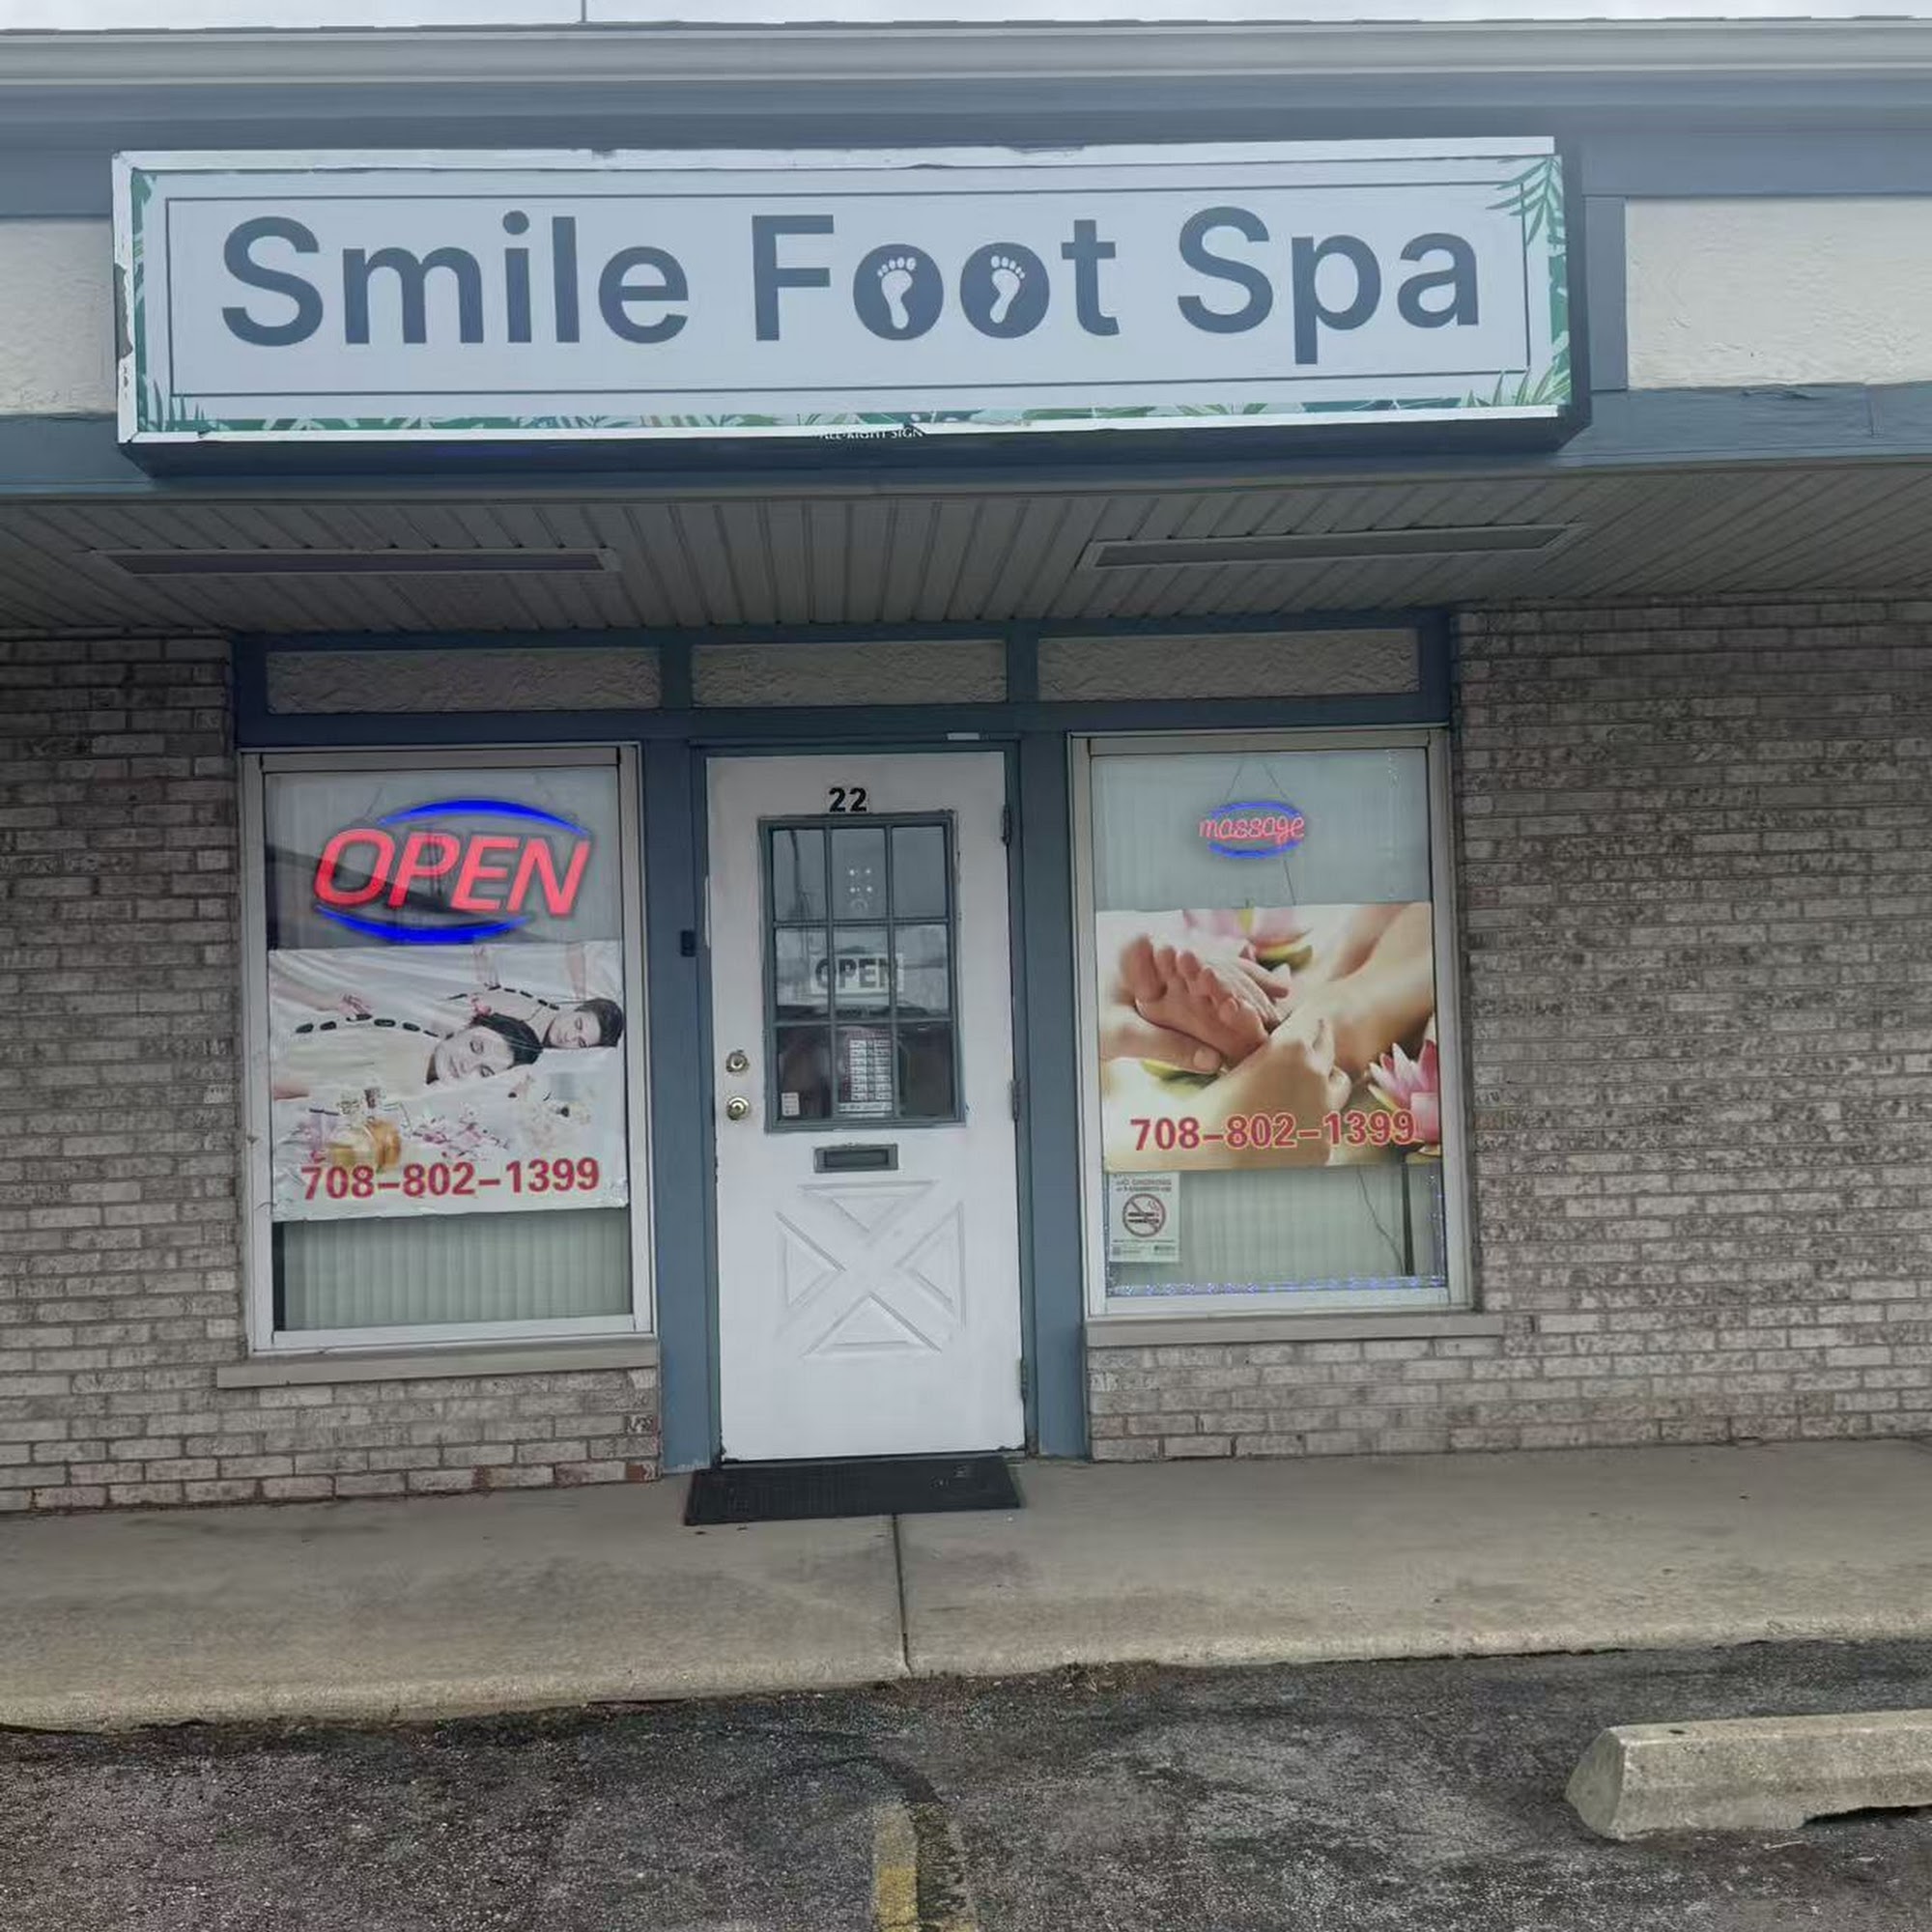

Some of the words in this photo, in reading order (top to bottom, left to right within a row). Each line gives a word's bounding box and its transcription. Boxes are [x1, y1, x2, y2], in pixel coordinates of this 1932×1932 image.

[221, 210, 689, 347] Smile
[752, 213, 1121, 342] Foot
[1177, 206, 1480, 365] Spa
[829, 787, 867, 812] 22
[1199, 815, 1304, 846] massage
[313, 827, 591, 916] OPEN
[1130, 1110, 1417, 1151] 708-802-1399
[301, 1157, 600, 1201] 708-802-1399
